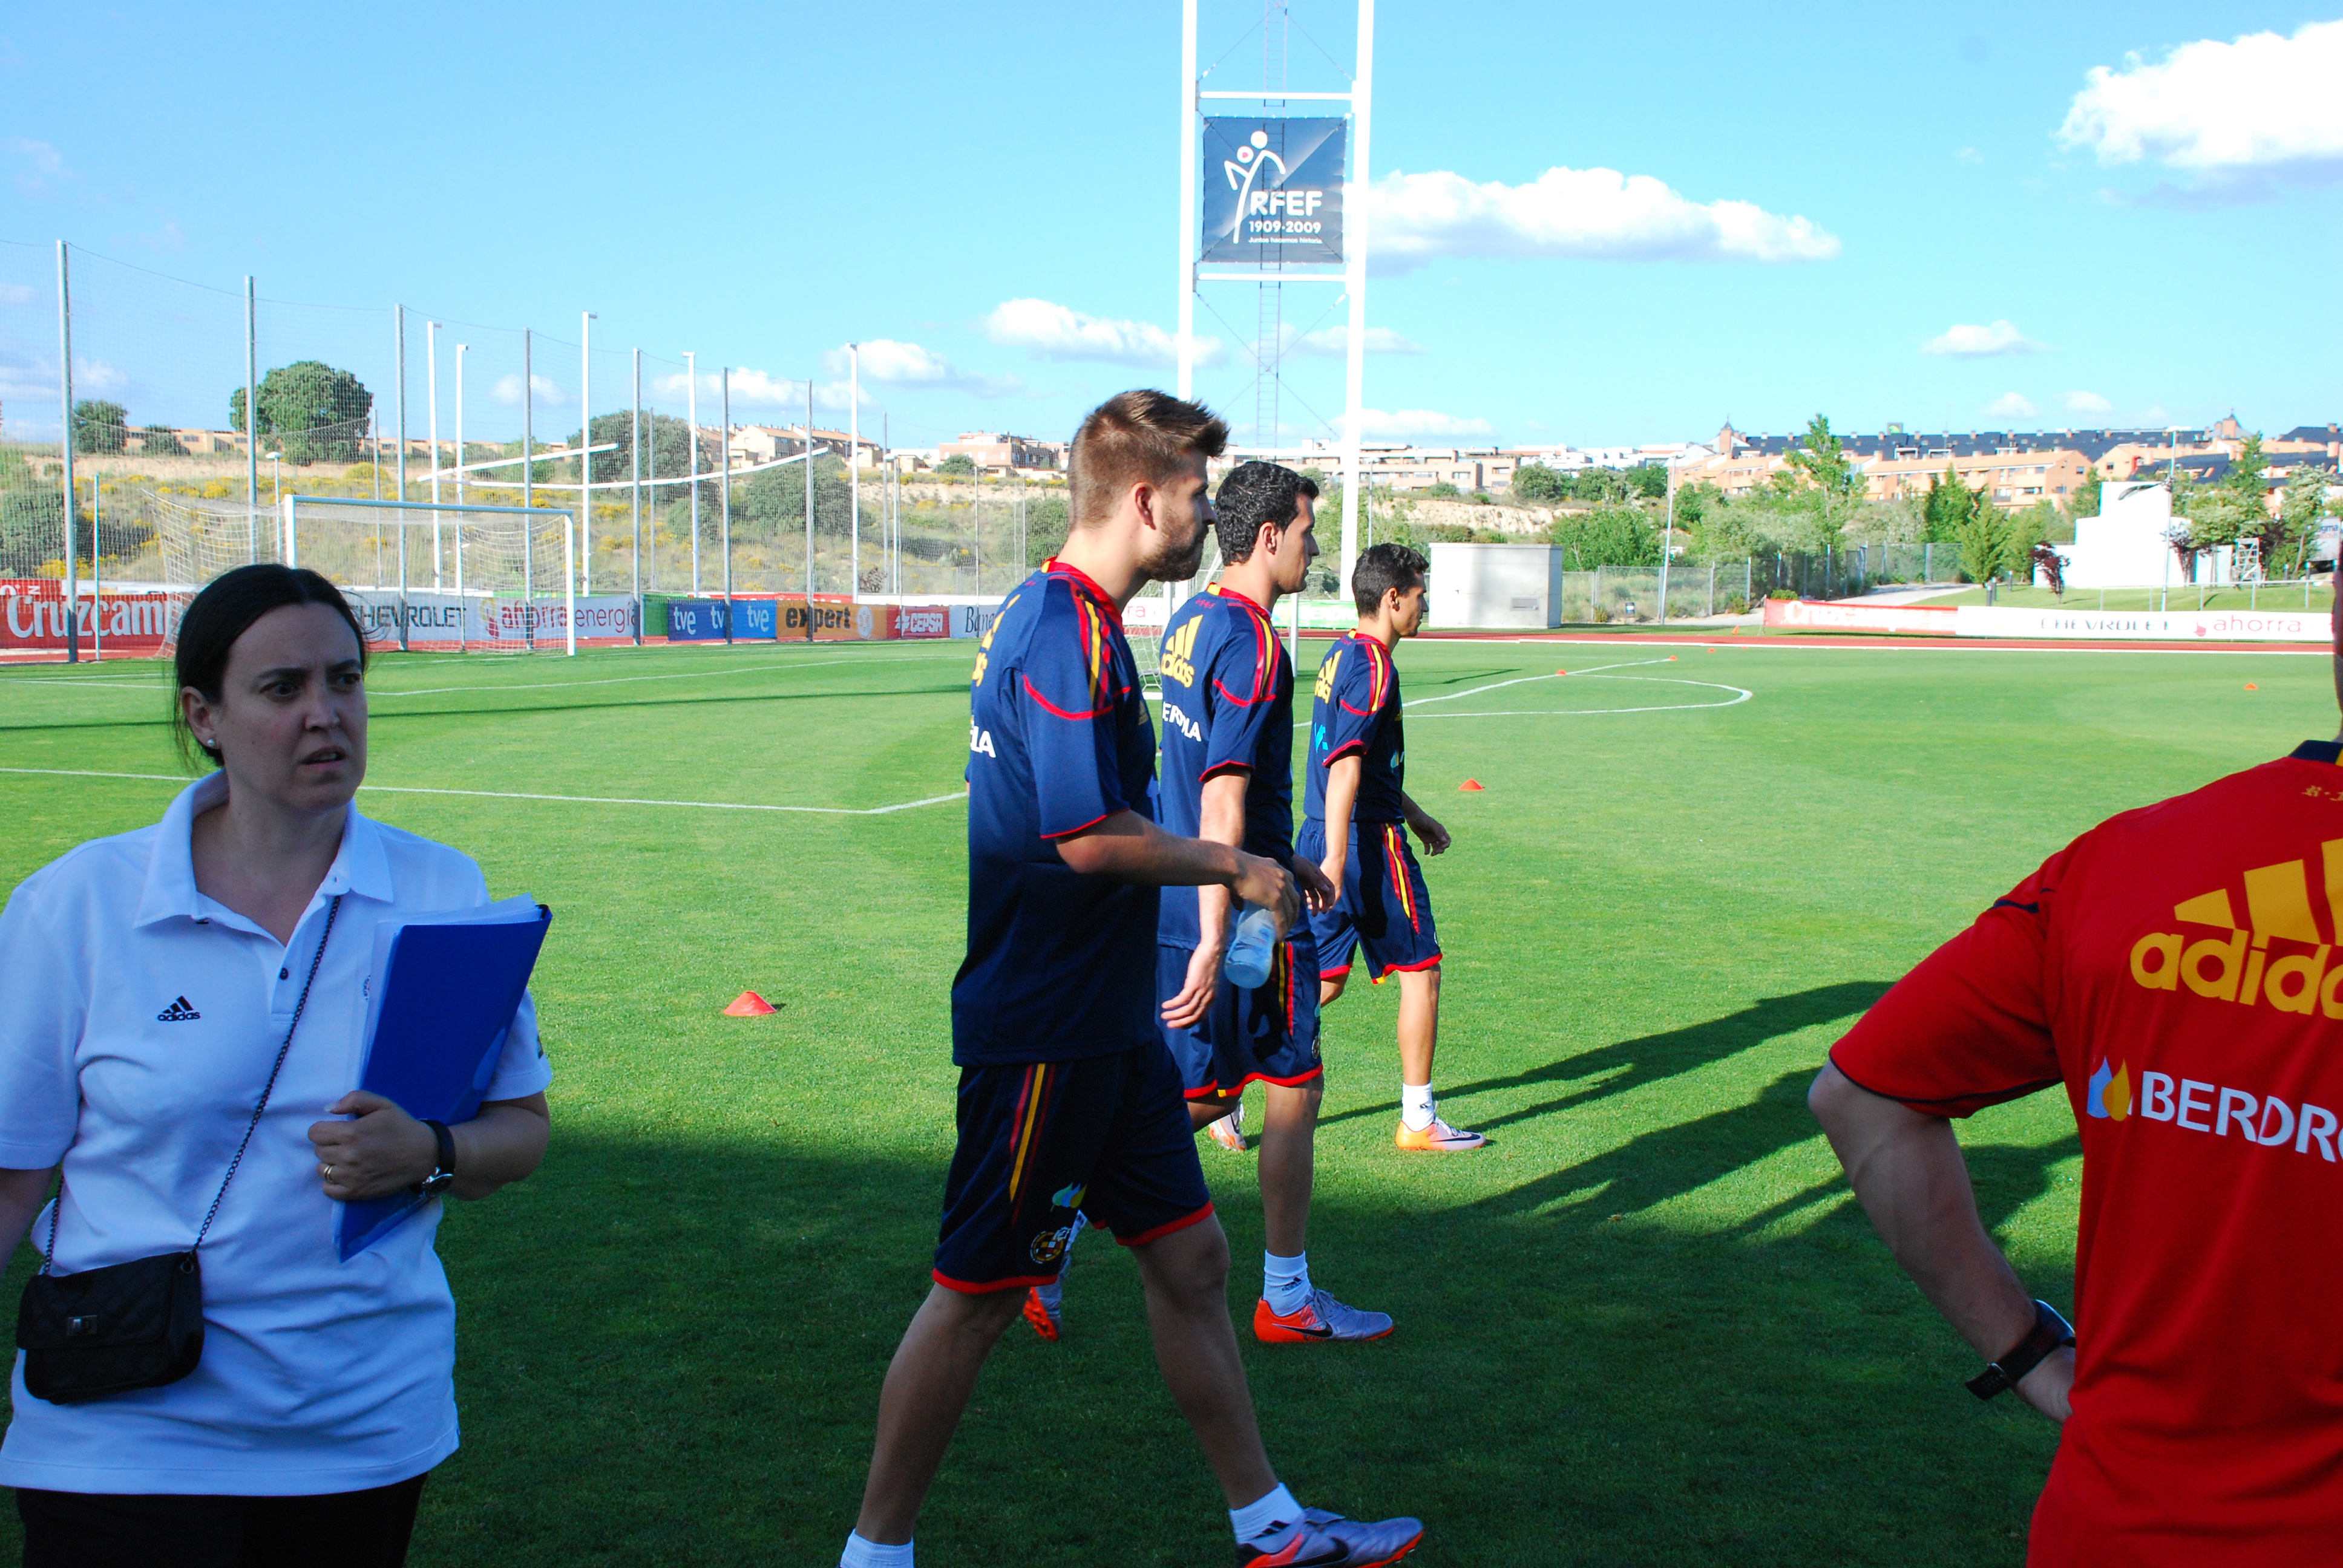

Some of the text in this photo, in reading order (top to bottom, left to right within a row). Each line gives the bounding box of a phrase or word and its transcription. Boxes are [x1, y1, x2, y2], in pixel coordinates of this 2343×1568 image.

[1250, 190, 1323, 216] RFEF
[7, 595, 184, 643] Cruzcamp
[673, 606, 770, 635] tve tv tve
[786, 607, 851, 634] expert
[910, 612, 944, 633] CEPSA
[965, 606, 994, 633] Bane
[2214, 615, 2301, 633] ahorra
[157, 1011, 202, 1022] adidas
[2127, 1071, 2343, 1163] BERDR
